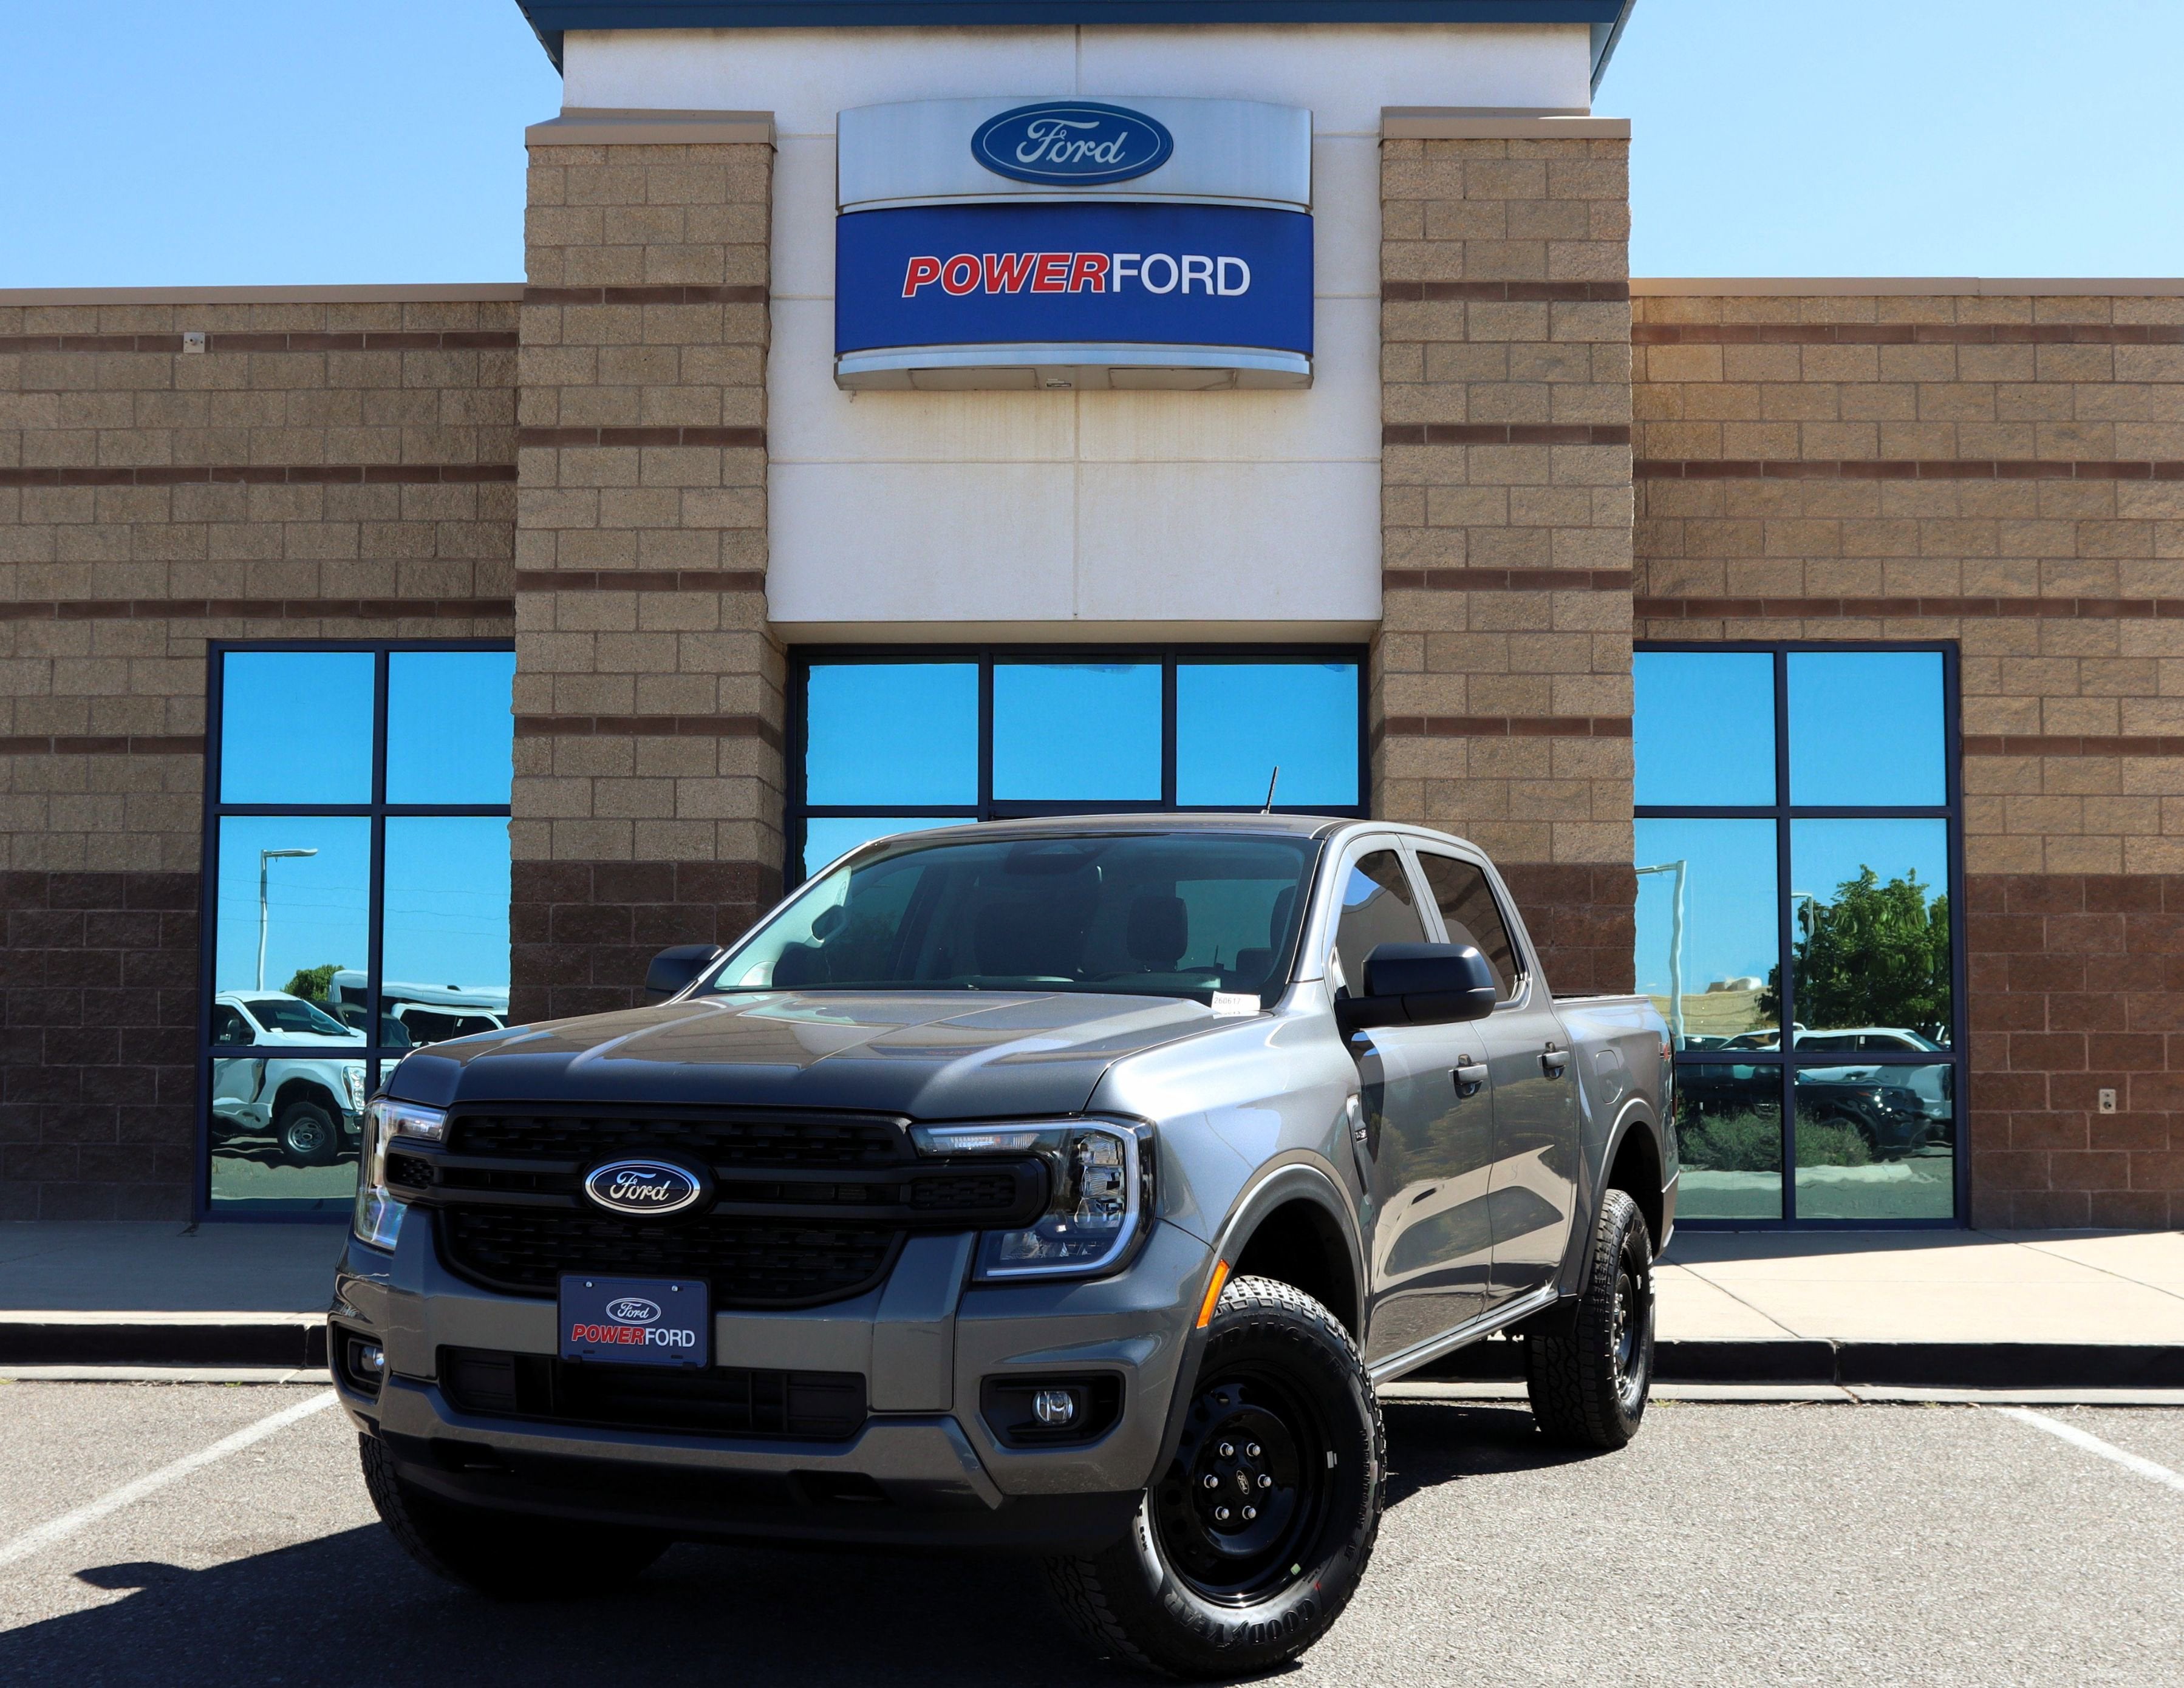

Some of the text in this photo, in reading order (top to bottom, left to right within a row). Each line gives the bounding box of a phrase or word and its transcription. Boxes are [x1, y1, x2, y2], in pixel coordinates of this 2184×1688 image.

[1016, 118, 1127, 164] Ford
[902, 252, 1251, 298] POWERFORD
[610, 1171, 671, 1200] Ford
[617, 1302, 650, 1319] Ford
[572, 1324, 695, 1347] POWERFORD
[1238, 1475, 1247, 1490] Ford
